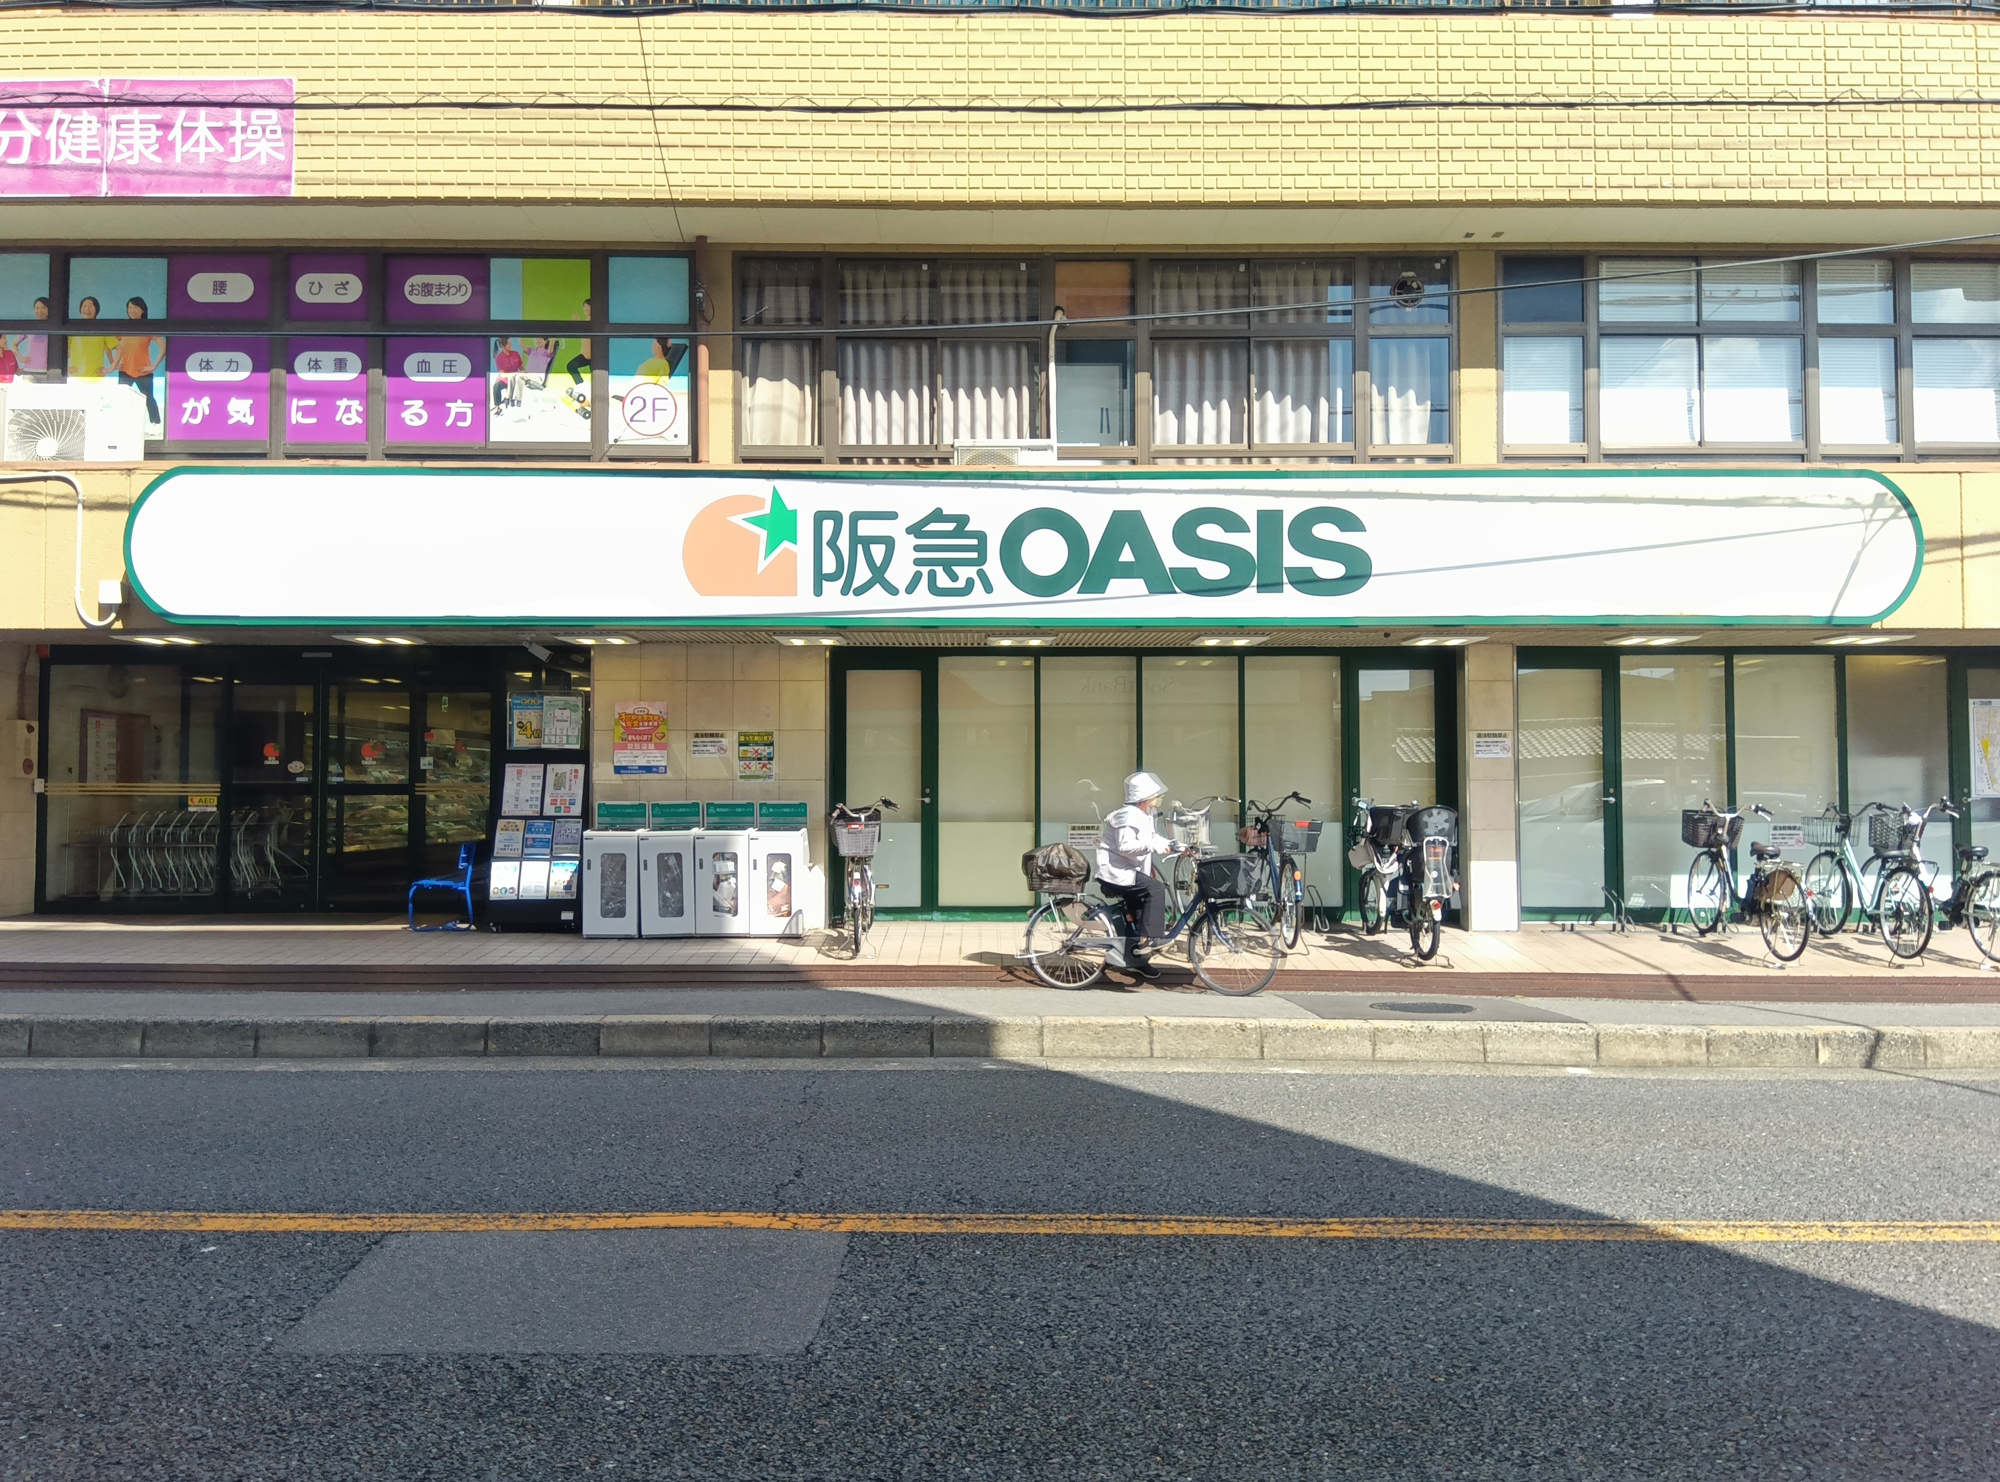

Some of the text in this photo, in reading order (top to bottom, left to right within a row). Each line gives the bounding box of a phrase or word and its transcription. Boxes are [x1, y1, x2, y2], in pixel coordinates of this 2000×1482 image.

[0, 110, 285, 165] 分健康体操
[212, 280, 228, 296] 腰
[308, 280, 350, 296] ひざ
[408, 282, 468, 298] お腹まわり
[198, 358, 240, 372] 体力
[306, 357, 349, 373] 体重
[416, 358, 458, 374] 血圧
[629, 396, 669, 423] 2F
